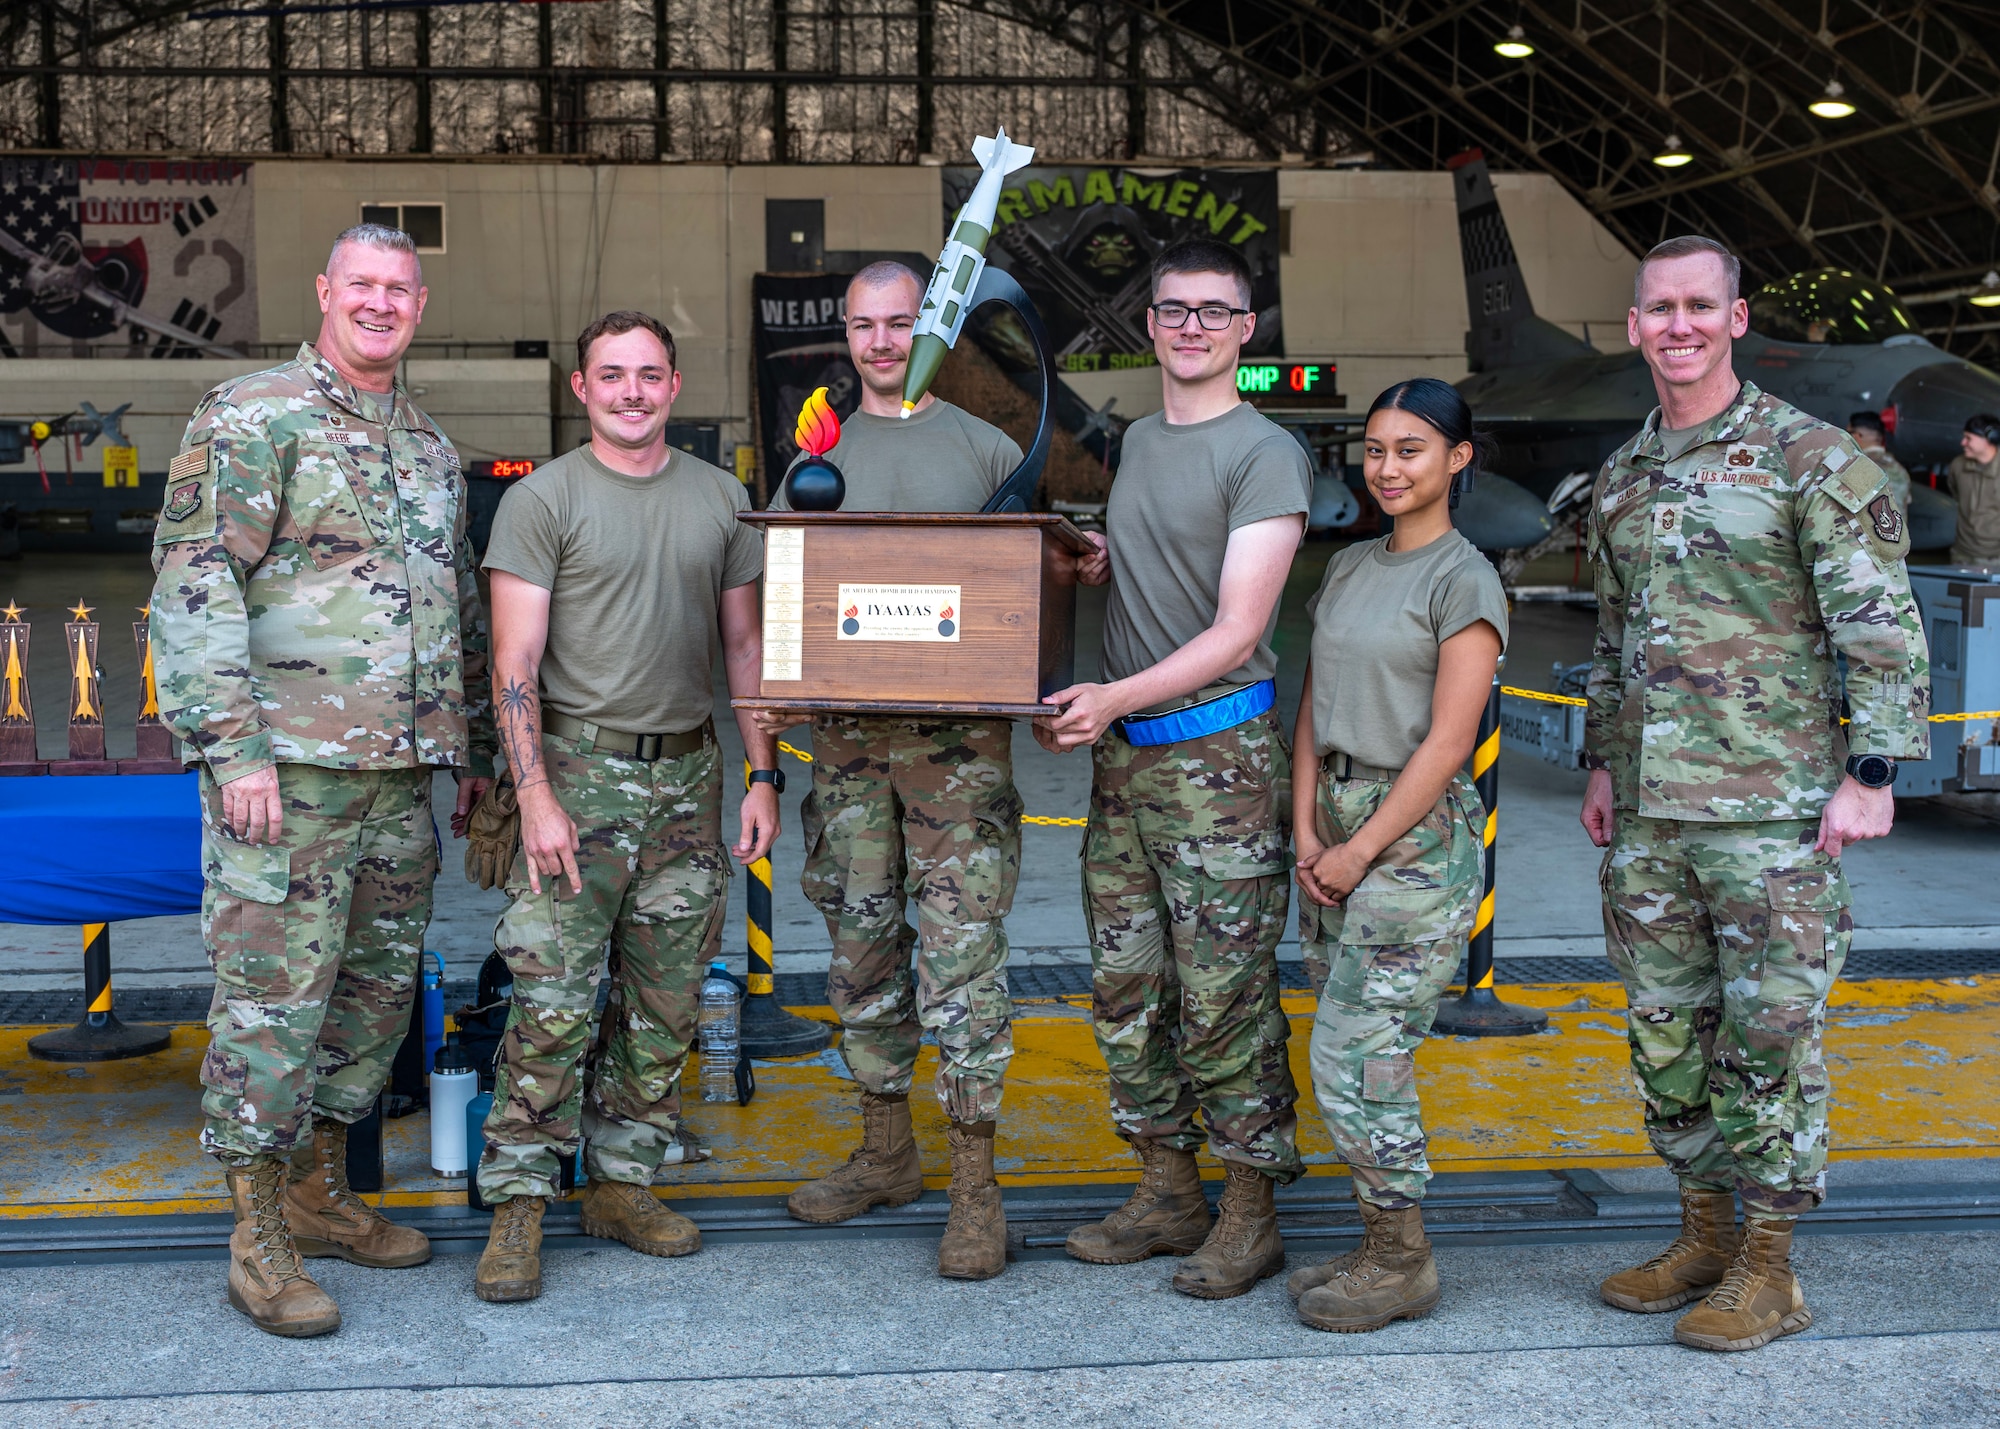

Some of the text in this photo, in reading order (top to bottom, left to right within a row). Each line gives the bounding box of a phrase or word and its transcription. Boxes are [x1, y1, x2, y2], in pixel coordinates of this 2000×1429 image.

[112, 160, 151, 187] TO
[165, 160, 251, 187] FIGHT
[67, 196, 194, 224] TONIGHT
[952, 169, 1267, 245] RMAMENT
[1066, 353, 1158, 372] GET SOME
[1289, 365, 1320, 391] OF
[324, 432, 352, 444] BEEBE
[1701, 471, 1771, 486] U.S. AIR FORCE
[1616, 484, 1638, 505] CLARK
[867, 604, 932, 616] IYAAYAS
